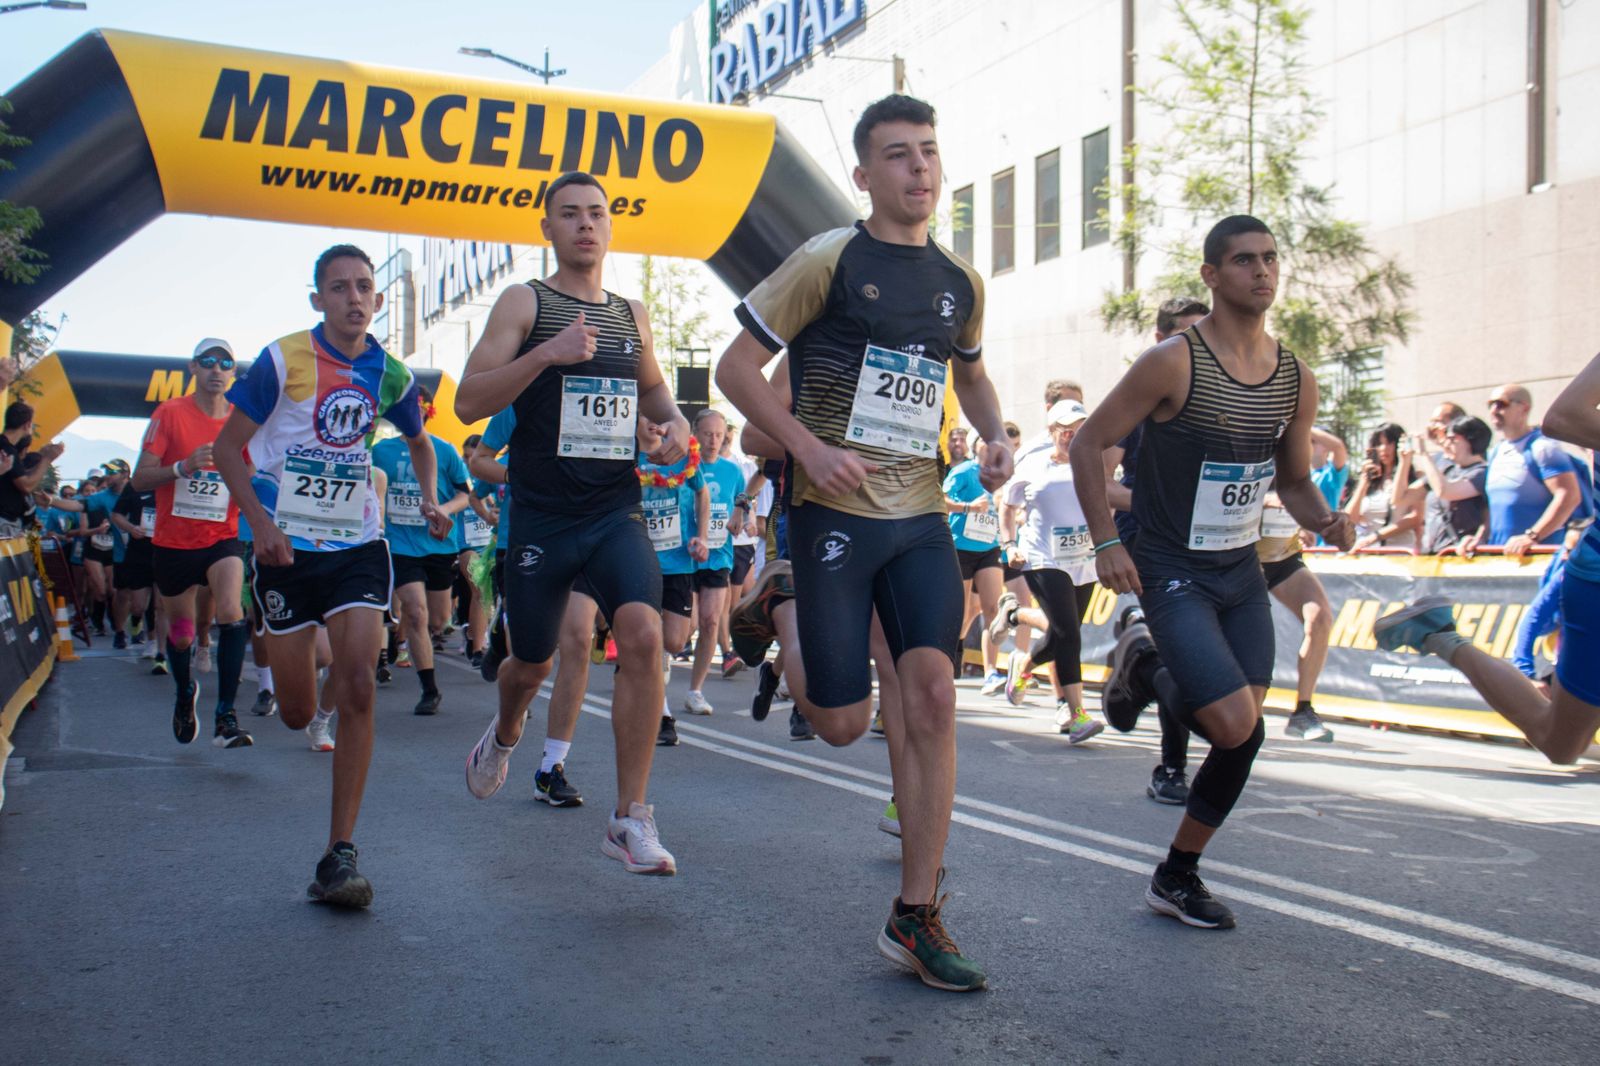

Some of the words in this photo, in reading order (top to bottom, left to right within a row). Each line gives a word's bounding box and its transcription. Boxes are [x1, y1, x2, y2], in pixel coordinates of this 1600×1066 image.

[200, 67, 704, 184] MARCELINO
[260, 165, 647, 217] www.mpmarceles
[875, 372, 936, 408] 2090
[577, 395, 630, 419] 1613
[891, 402, 922, 415] RODRIGO
[593, 419, 618, 427] ANYELO
[188, 480, 219, 496] 522
[294, 475, 357, 502] 2377
[315, 501, 335, 509] ADAM
[393, 496, 420, 507] 1633
[973, 513, 995, 526] 1804
